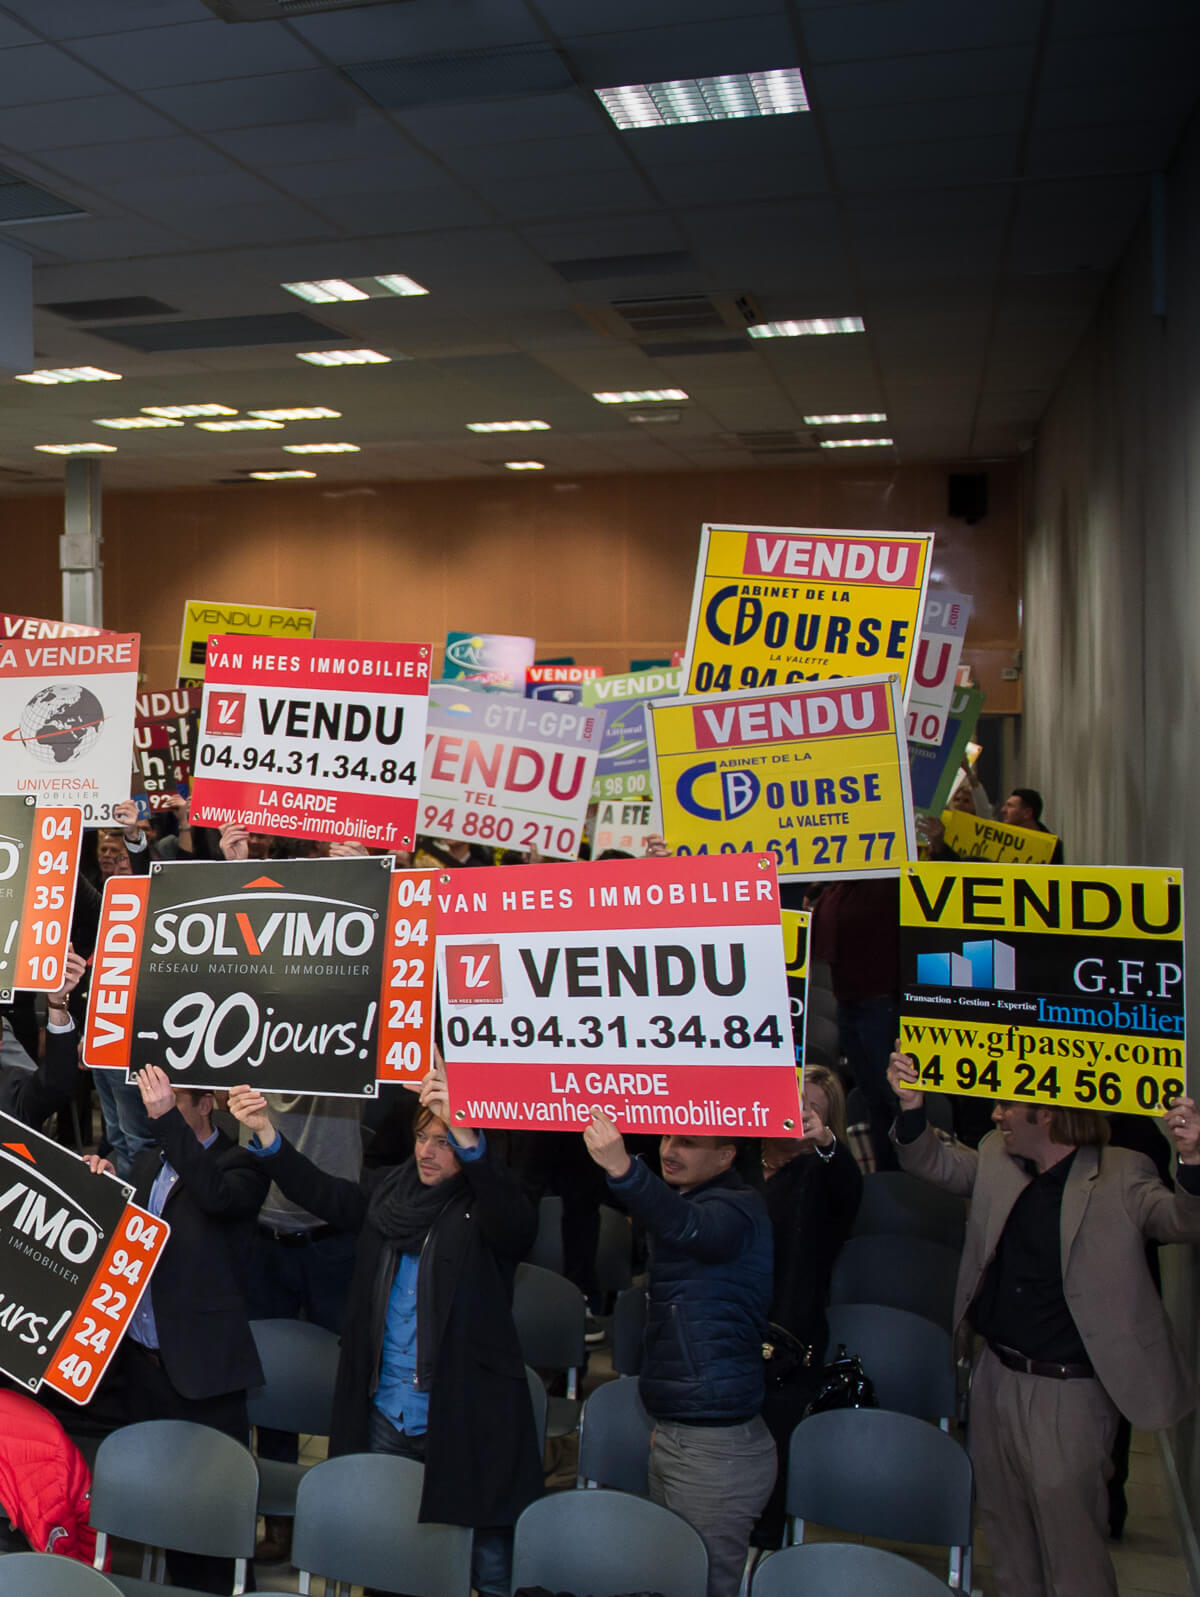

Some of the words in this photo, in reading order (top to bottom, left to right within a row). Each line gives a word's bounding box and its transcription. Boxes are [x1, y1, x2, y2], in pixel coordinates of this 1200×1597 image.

[755, 537, 909, 582] VENDU
[805, 589, 825, 601] DE
[831, 590, 850, 603] LA
[189, 608, 263, 628] VENDU
[268, 615, 312, 632] PAR
[0, 649, 17, 669] A
[25, 643, 132, 667] VENDRE
[208, 653, 243, 669] VAN
[252, 654, 300, 671] HEES
[310, 657, 429, 678] IMMOBILIER
[786, 656, 829, 666] VALETTE
[530, 668, 596, 683] VENDU
[594, 672, 682, 699] VENDU
[258, 698, 405, 745] VENDU
[485, 703, 585, 741] GTI-GPI
[583, 717, 595, 743] .com
[703, 691, 875, 743] VENDU
[199, 743, 417, 786] 04.94.31.34.84
[16, 777, 99, 791] UNIVERSAL
[464, 790, 497, 807] TEL
[258, 789, 278, 806] LA
[281, 791, 337, 813] GARDE
[41, 816, 72, 840] 04
[201, 805, 398, 842] www.vanhees-immobilier.fr
[462, 811, 514, 842] 880
[520, 822, 575, 853] 210
[778, 816, 795, 829] LA
[797, 812, 849, 828] VALETTE
[812, 834, 848, 865] 27
[858, 831, 896, 862] 77
[975, 822, 1025, 851] VENDU
[37, 851, 69, 875] 94
[33, 886, 64, 910] 35
[398, 879, 431, 907] 04
[438, 892, 487, 913] VAN
[503, 888, 573, 910] HEES
[589, 879, 773, 907] IMMOBILIER
[908, 874, 1182, 935] VENDU
[31, 920, 61, 945] 10
[150, 912, 375, 956] SOLVIMO
[394, 919, 428, 947] 94
[28, 956, 58, 980] 10
[93, 892, 141, 1048] VENDU
[150, 959, 199, 975] RÉSEAU
[208, 963, 276, 976] NATIONAL
[285, 964, 370, 976] IMMOBILIER
[390, 959, 425, 987] 22
[518, 943, 746, 998] VENDU
[1073, 958, 1183, 999] G.F.P
[388, 1001, 423, 1029] 24
[904, 992, 952, 1005] Transaction
[959, 997, 990, 1007] Gestion
[997, 1000, 1037, 1012] Expertise
[1037, 997, 1184, 1034] Immobilier
[447, 1014, 784, 1049] 04.94.31.34.84
[903, 1023, 1183, 1068] www.gfpassy.com
[385, 1041, 421, 1071] 40
[550, 1072, 580, 1094] LA
[585, 1073, 669, 1096] GARDE
[956, 1056, 1001, 1092] 94
[1013, 1063, 1061, 1099] 24
[1074, 1069, 1122, 1106] 56
[125, 1215, 156, 1250] 04
[8, 1236, 78, 1285] IMMOBILIER
[108, 1250, 139, 1285] 94
[91, 1284, 127, 1320] 22
[74, 1318, 107, 1354] 24
[58, 1353, 92, 1387] 40
